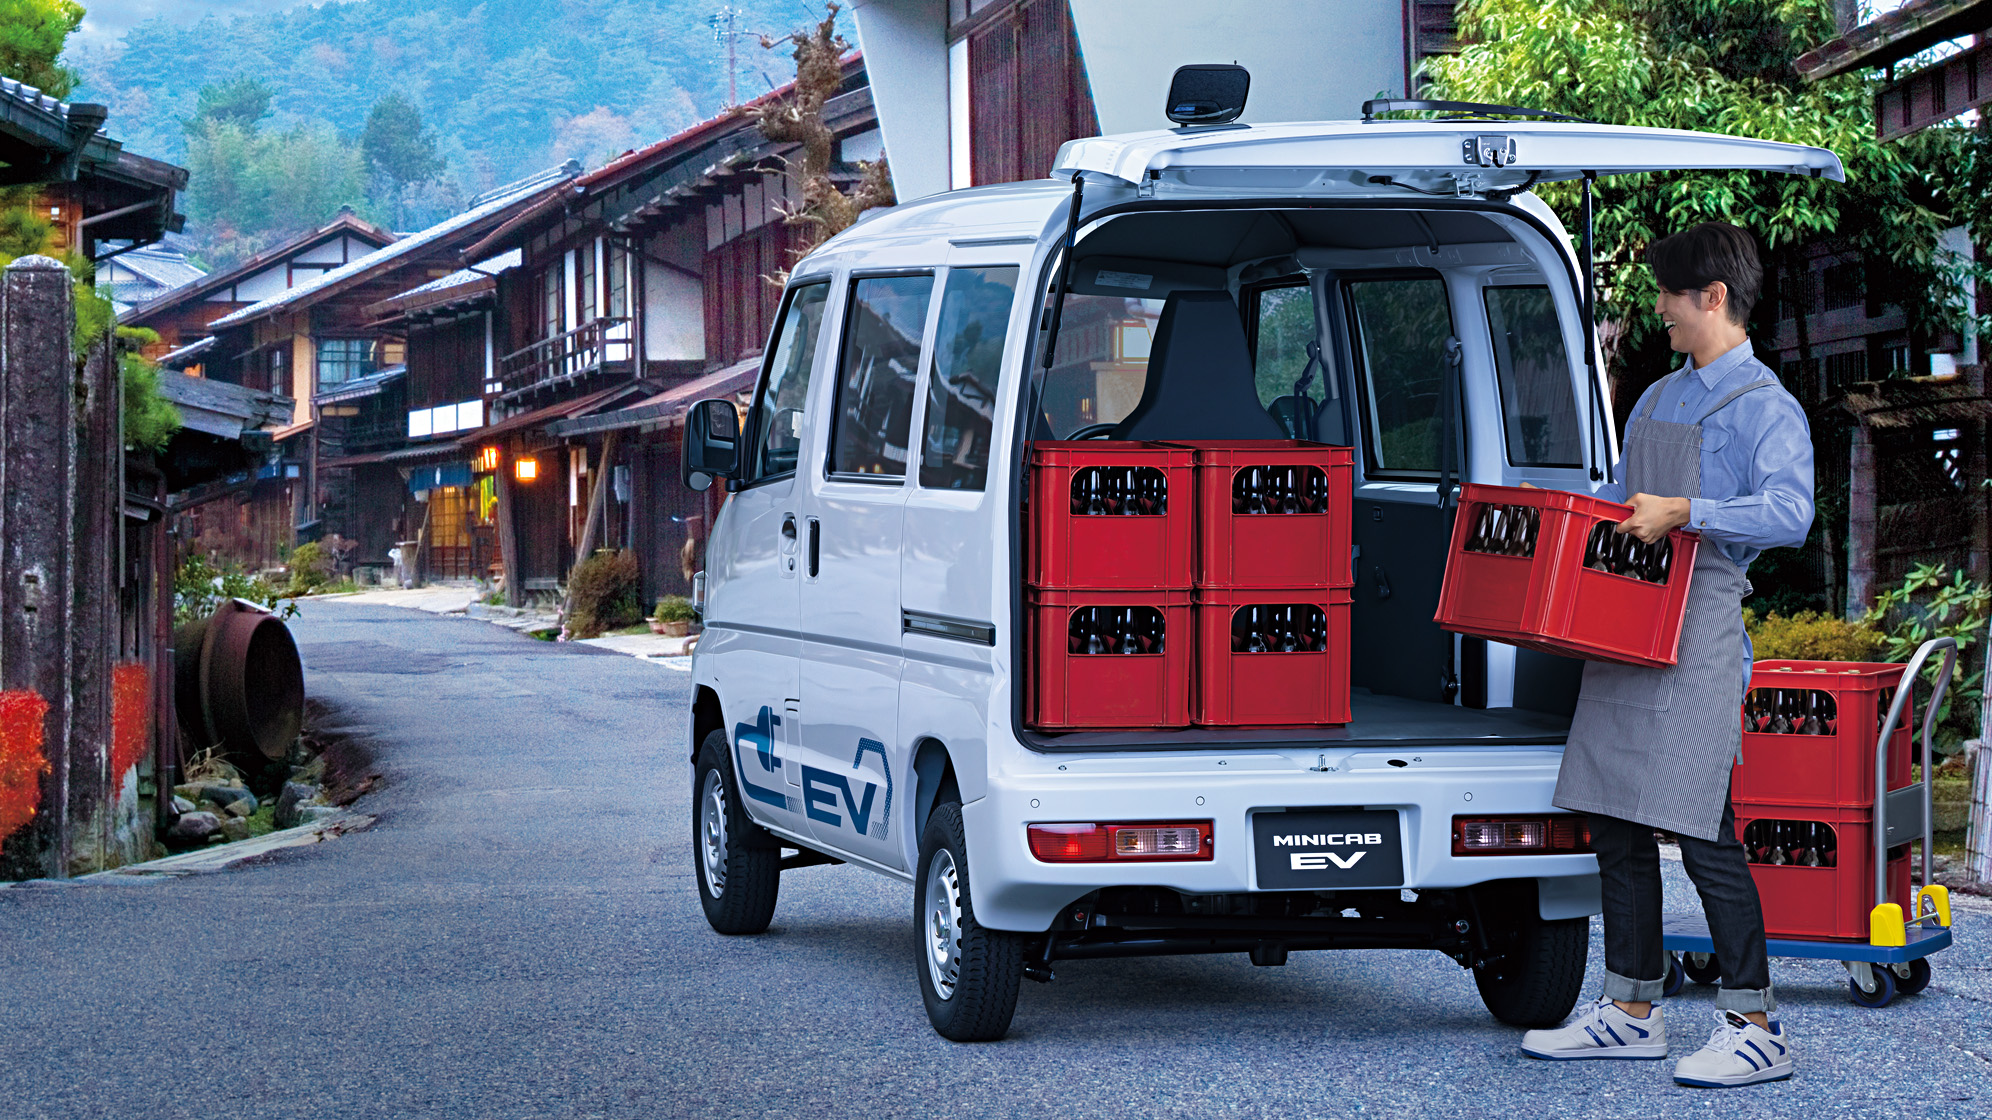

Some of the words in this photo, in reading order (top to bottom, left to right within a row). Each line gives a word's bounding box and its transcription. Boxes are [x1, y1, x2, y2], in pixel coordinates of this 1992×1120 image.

[801, 764, 877, 836] EV
[1273, 833, 1382, 847] MINICAB
[1290, 851, 1367, 870] EV
